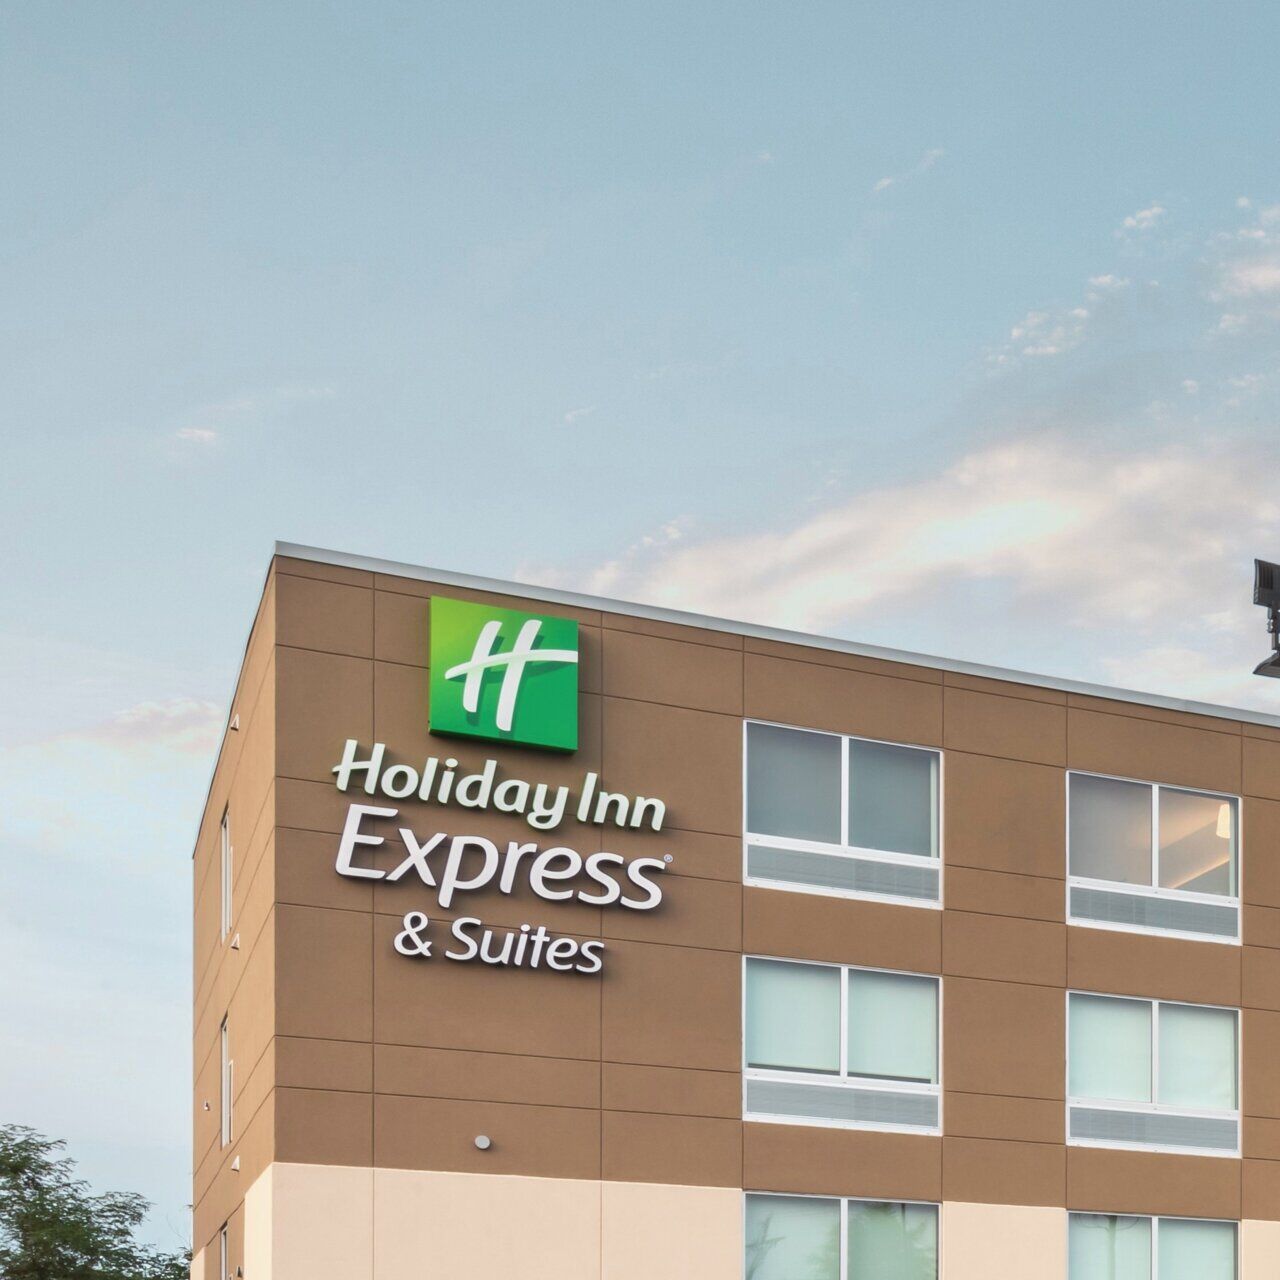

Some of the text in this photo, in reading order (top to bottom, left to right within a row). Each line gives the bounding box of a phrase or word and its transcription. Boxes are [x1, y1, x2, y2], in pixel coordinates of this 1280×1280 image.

[332, 739, 667, 832] Holiday Inn
[394, 911, 605, 974] & Suites
